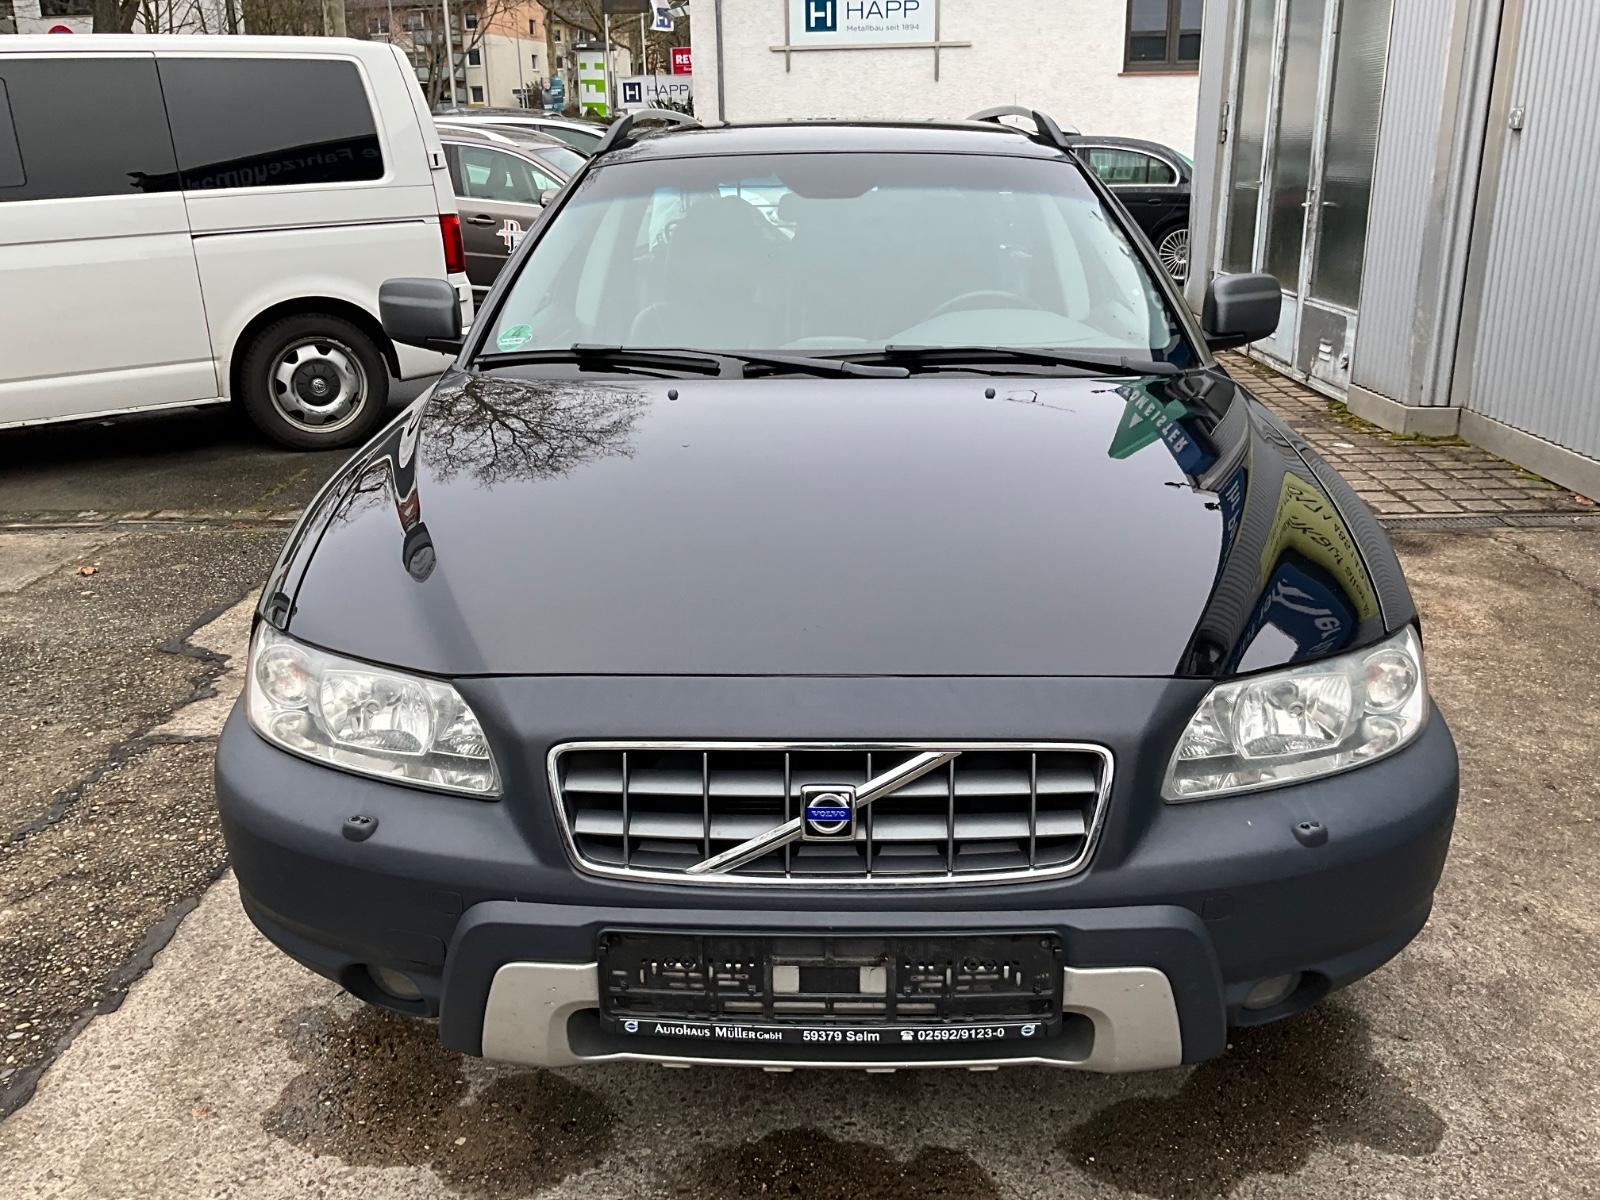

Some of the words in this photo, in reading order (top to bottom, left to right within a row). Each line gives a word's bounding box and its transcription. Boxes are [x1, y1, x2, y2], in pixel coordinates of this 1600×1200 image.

[846, 0, 920, 20] HAPP
[846, 24, 884, 32] Metallbau
[902, 23, 920, 31] 1894
[646, 84, 689, 97] HAPP
[802, 1029, 842, 1042] 59379
[845, 1030, 880, 1042] Selm
[917, 1027, 1006, 1041] 02592/9123-0
